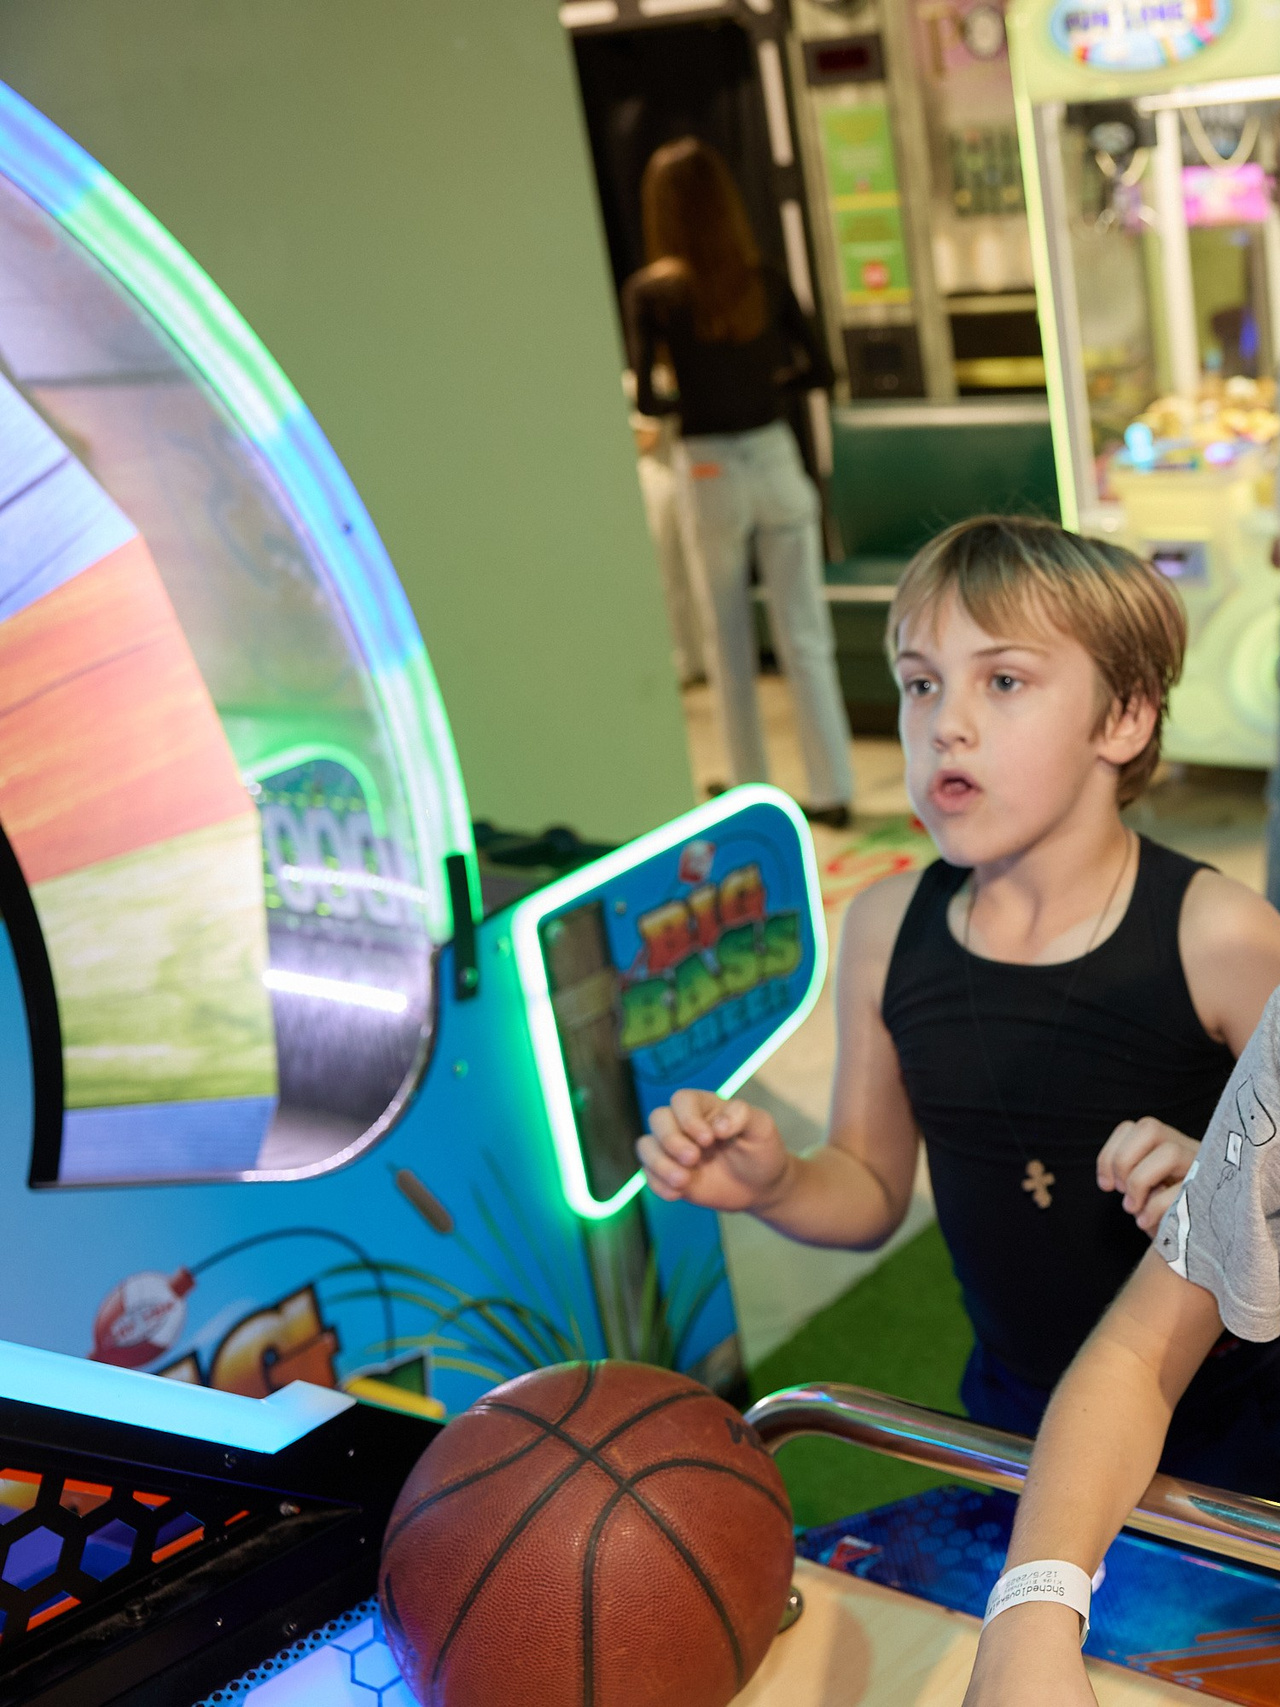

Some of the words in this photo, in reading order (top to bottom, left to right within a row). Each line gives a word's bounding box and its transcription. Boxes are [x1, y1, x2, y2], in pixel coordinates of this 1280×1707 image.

[638, 864, 768, 973] BIG
[620, 912, 801, 1049] BASS
[631, 976, 792, 1078] WHEEL
